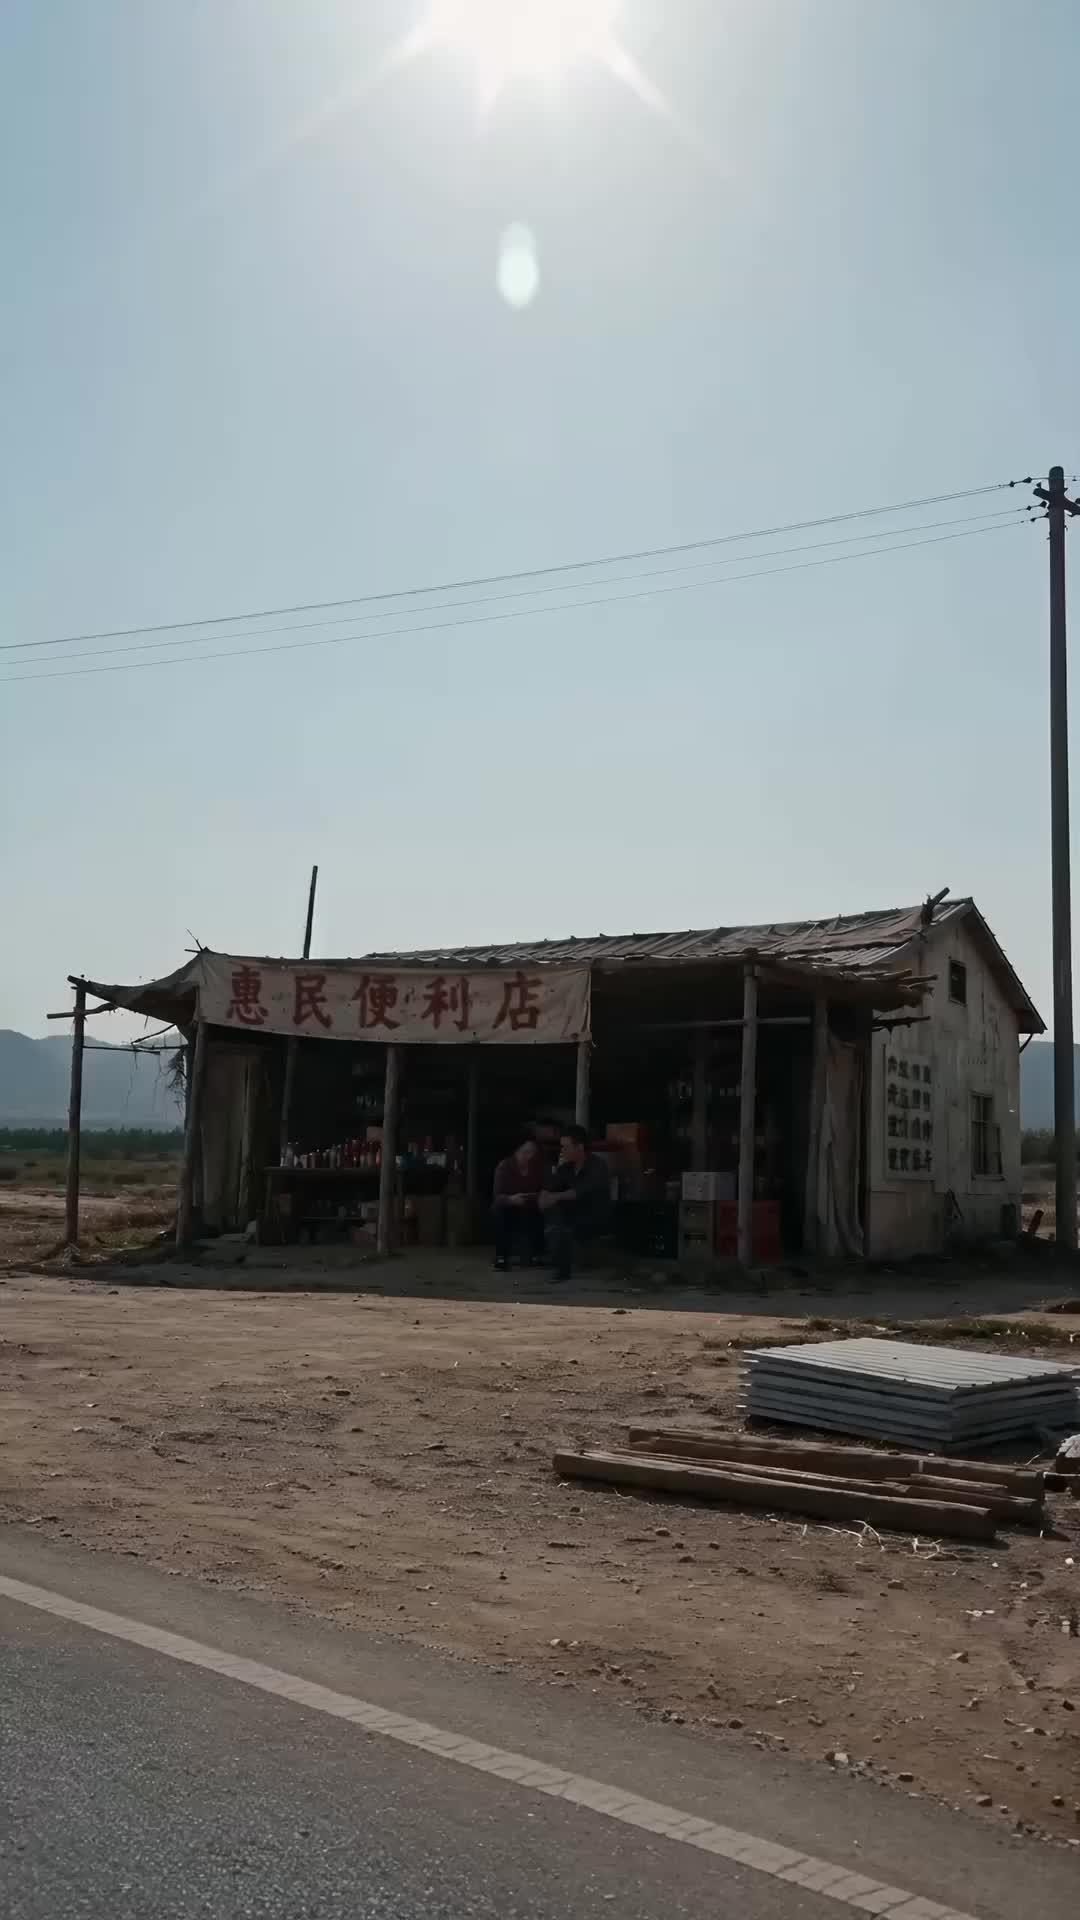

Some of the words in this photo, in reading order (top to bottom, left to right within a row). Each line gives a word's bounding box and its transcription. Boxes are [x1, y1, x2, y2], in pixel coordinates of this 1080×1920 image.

[227, 966, 544, 1031] 惠民便利店
